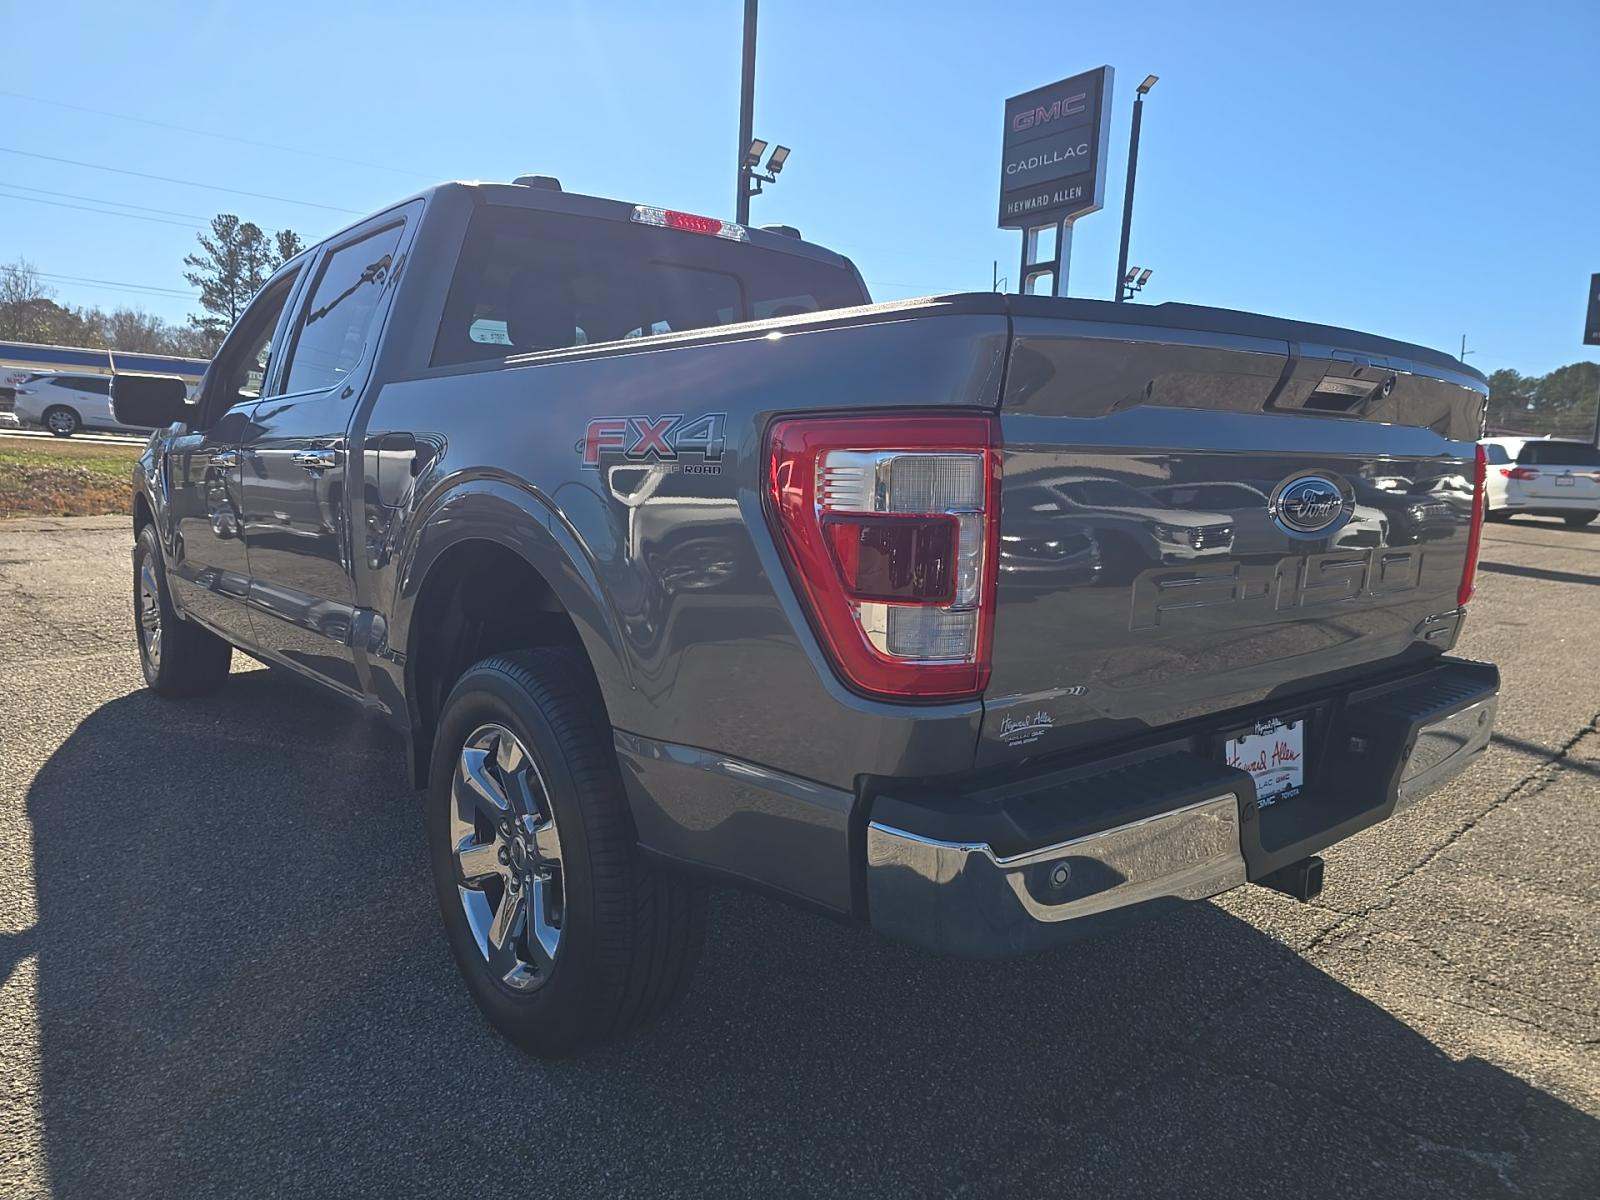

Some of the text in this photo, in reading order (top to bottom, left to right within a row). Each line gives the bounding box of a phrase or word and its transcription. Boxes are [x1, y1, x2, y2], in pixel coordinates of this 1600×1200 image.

[1013, 93, 1086, 132] GMC
[1007, 143, 1088, 175] CADILLAC
[1008, 187, 1082, 214] HEYWARD ALLEN
[578, 413, 727, 470] FX4
[684, 464, 722, 475] ROAD
[1297, 488, 1341, 518] Ford
